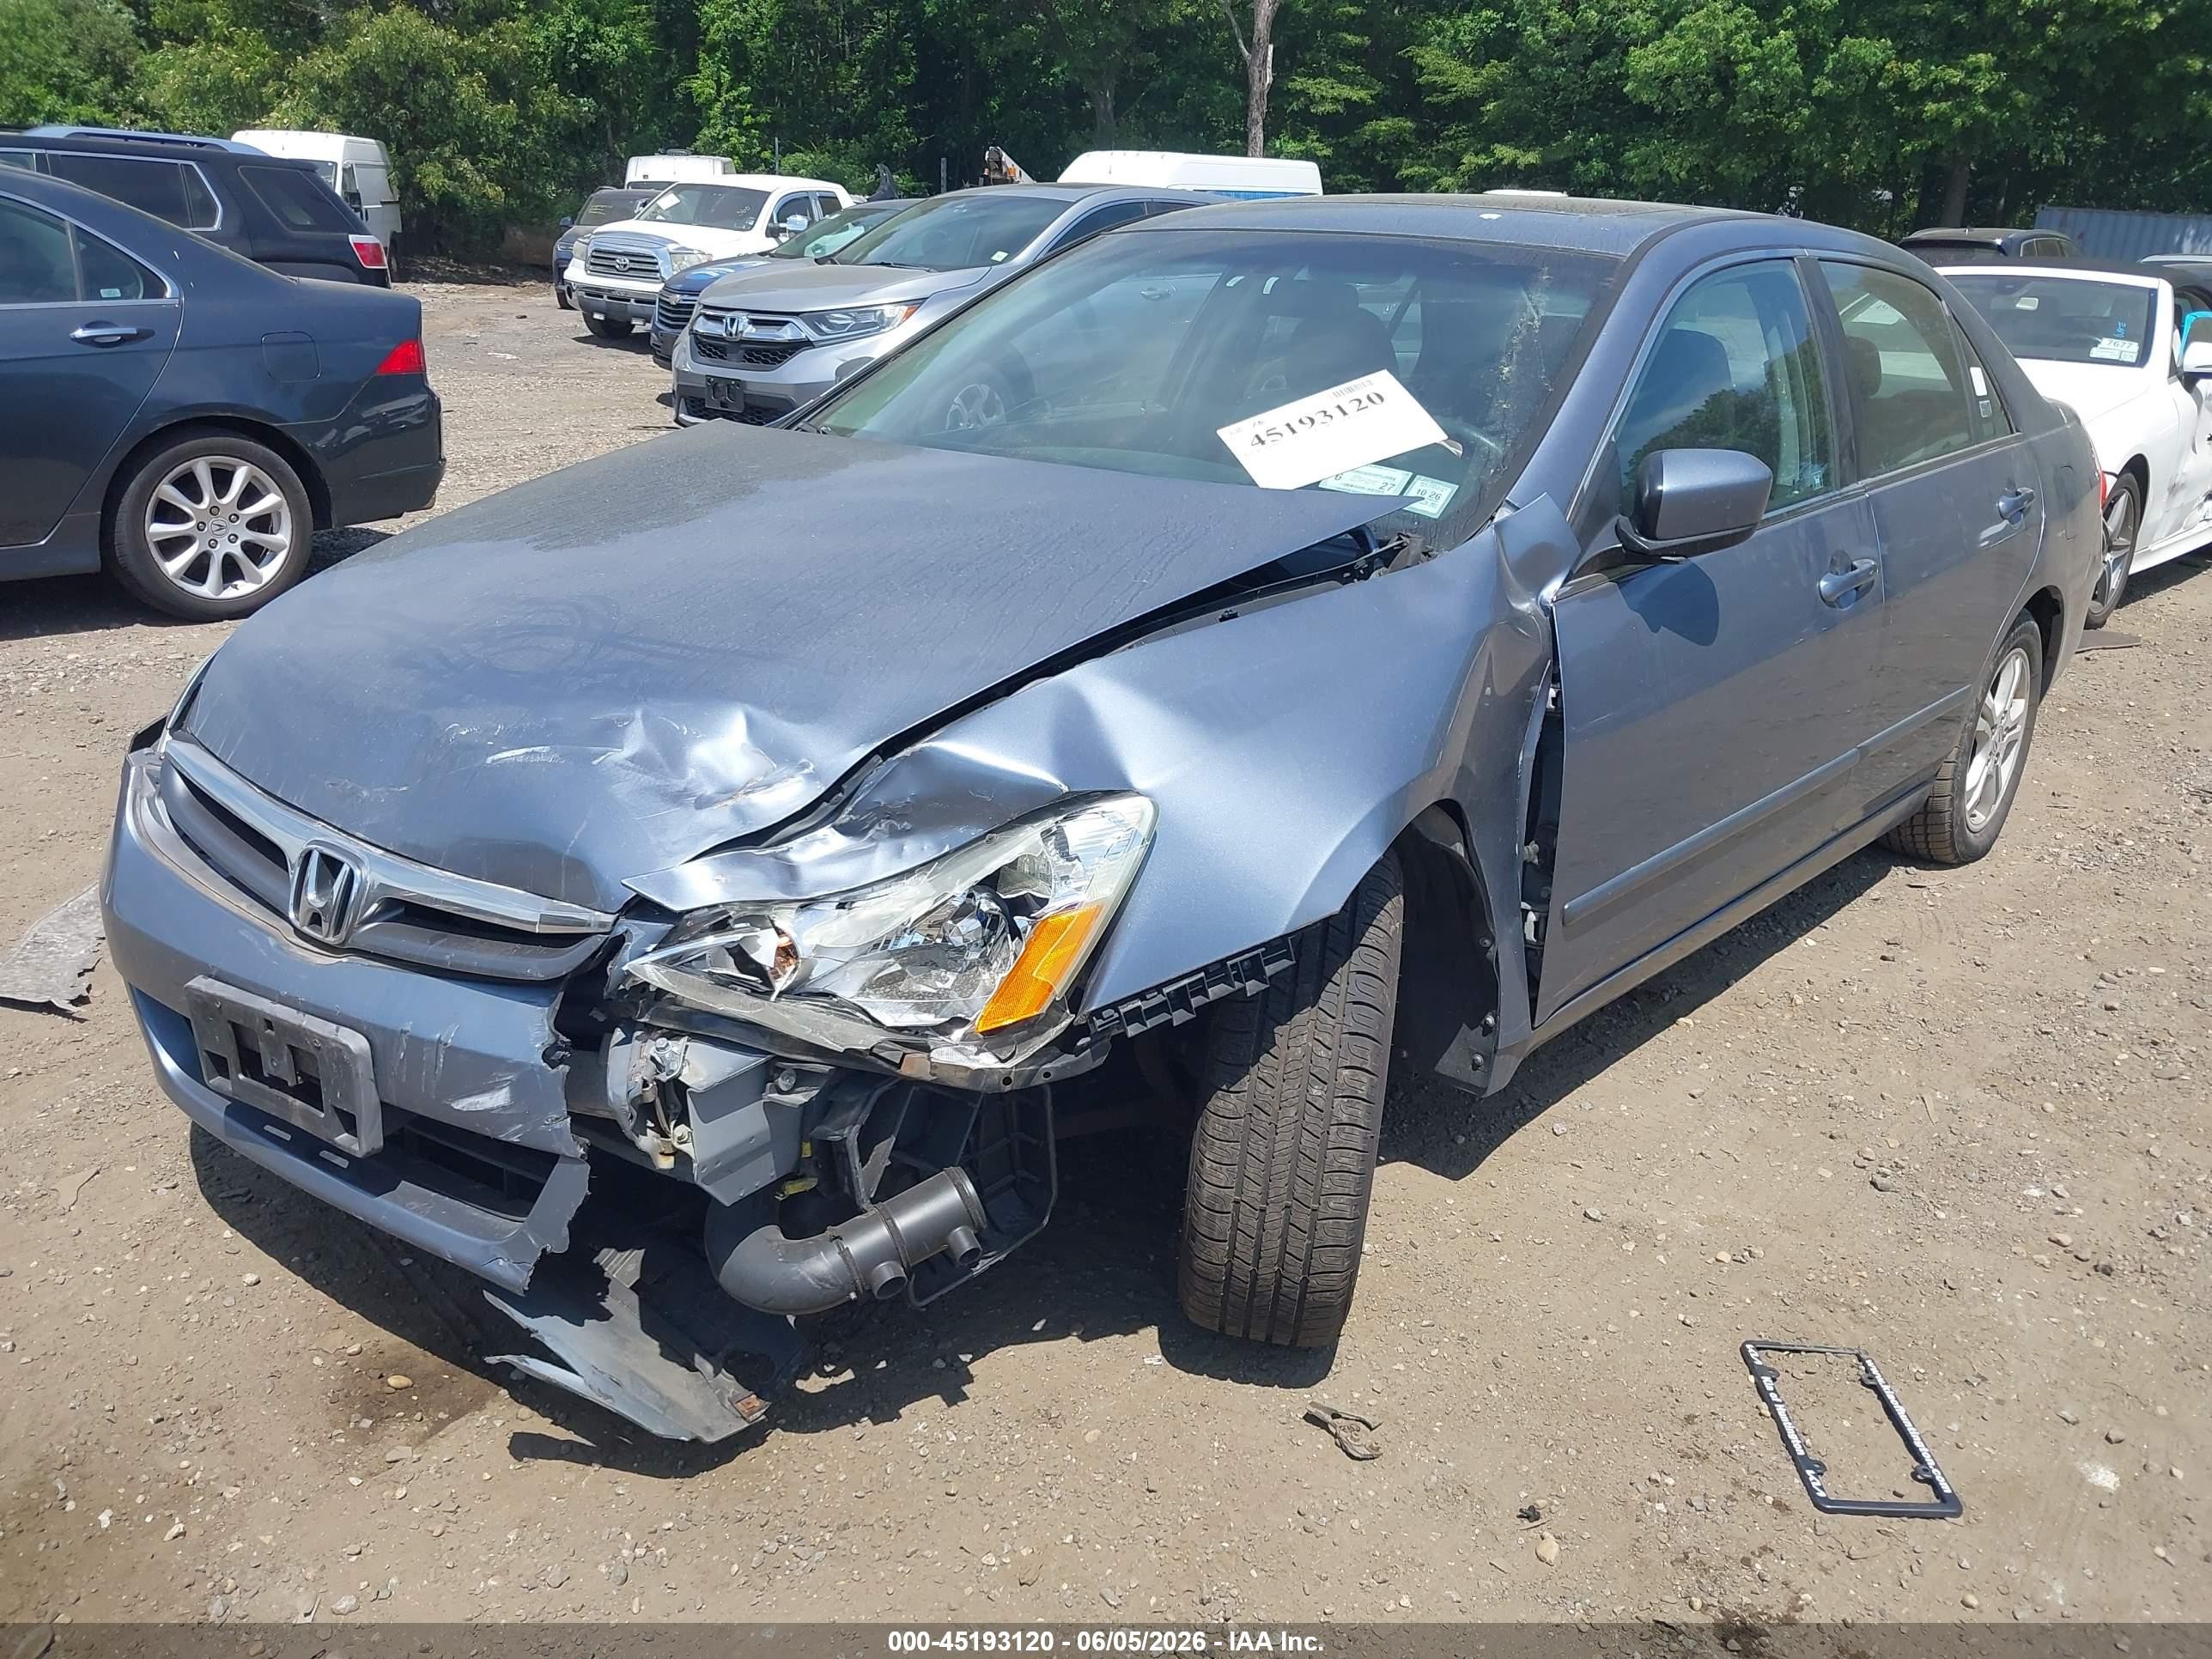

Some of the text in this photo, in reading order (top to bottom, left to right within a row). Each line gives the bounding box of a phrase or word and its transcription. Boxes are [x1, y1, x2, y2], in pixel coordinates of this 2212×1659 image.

[1249, 392, 1385, 447] 45193120
[1378, 482, 1396, 491] 27
[1428, 490, 1443, 501] 26
[1760, 1376, 1805, 1455] Kia of Huntington
[1865, 1358, 1953, 1494] www.kiaofhuntington.com
